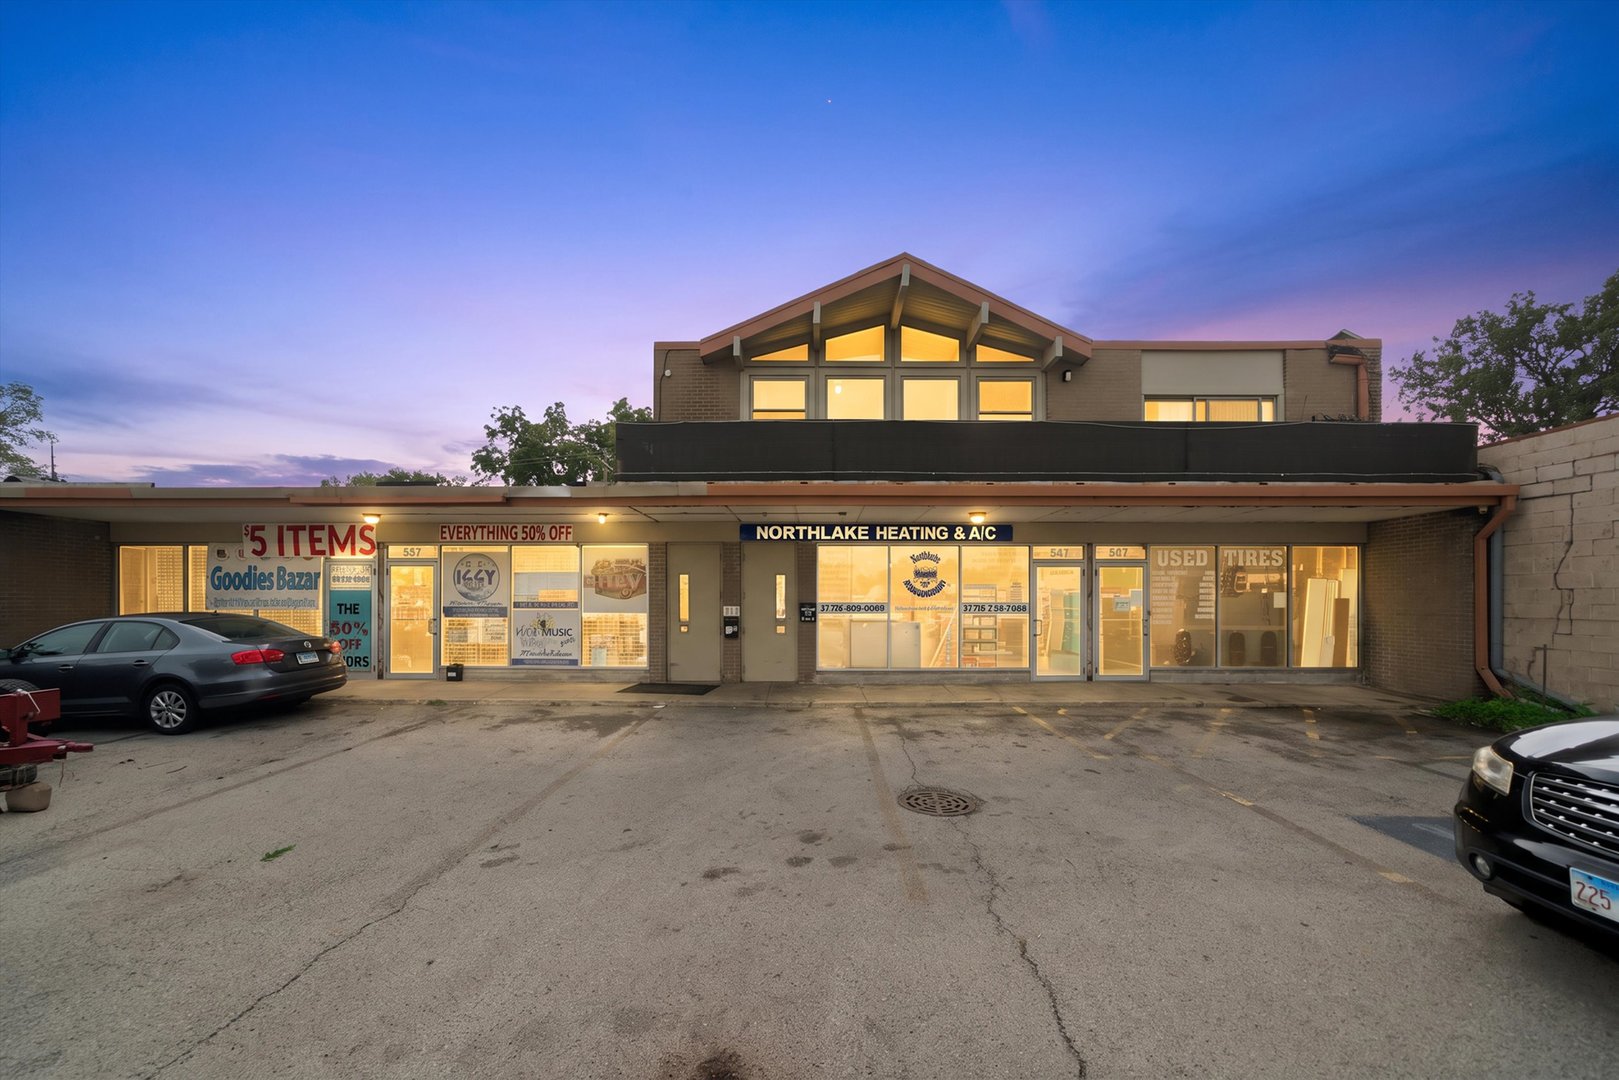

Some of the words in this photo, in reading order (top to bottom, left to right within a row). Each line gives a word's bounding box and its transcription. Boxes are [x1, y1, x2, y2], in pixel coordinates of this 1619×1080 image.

[277, 524, 377, 557] ITEMS
[440, 525, 518, 541] EVERYTHING
[521, 525, 546, 541] 50%
[549, 525, 573, 541] OFF
[756, 525, 869, 540] NORTHLAKE
[876, 525, 948, 540] HEATING
[953, 526, 966, 540] &
[968, 525, 997, 541] A/C
[1050, 548, 1069, 558] 547
[1157, 549, 1208, 567] USED
[1223, 549, 1284, 567] TIRES
[210, 565, 274, 591] Goodies
[276, 565, 321, 591] Bazar
[337, 603, 360, 615] THE
[330, 621, 368, 636] 50%
[541, 628, 573, 637] MUSIC
[339, 639, 362, 650] OFF
[343, 656, 369, 668] ORS
[1576, 881, 1611, 910] 225
